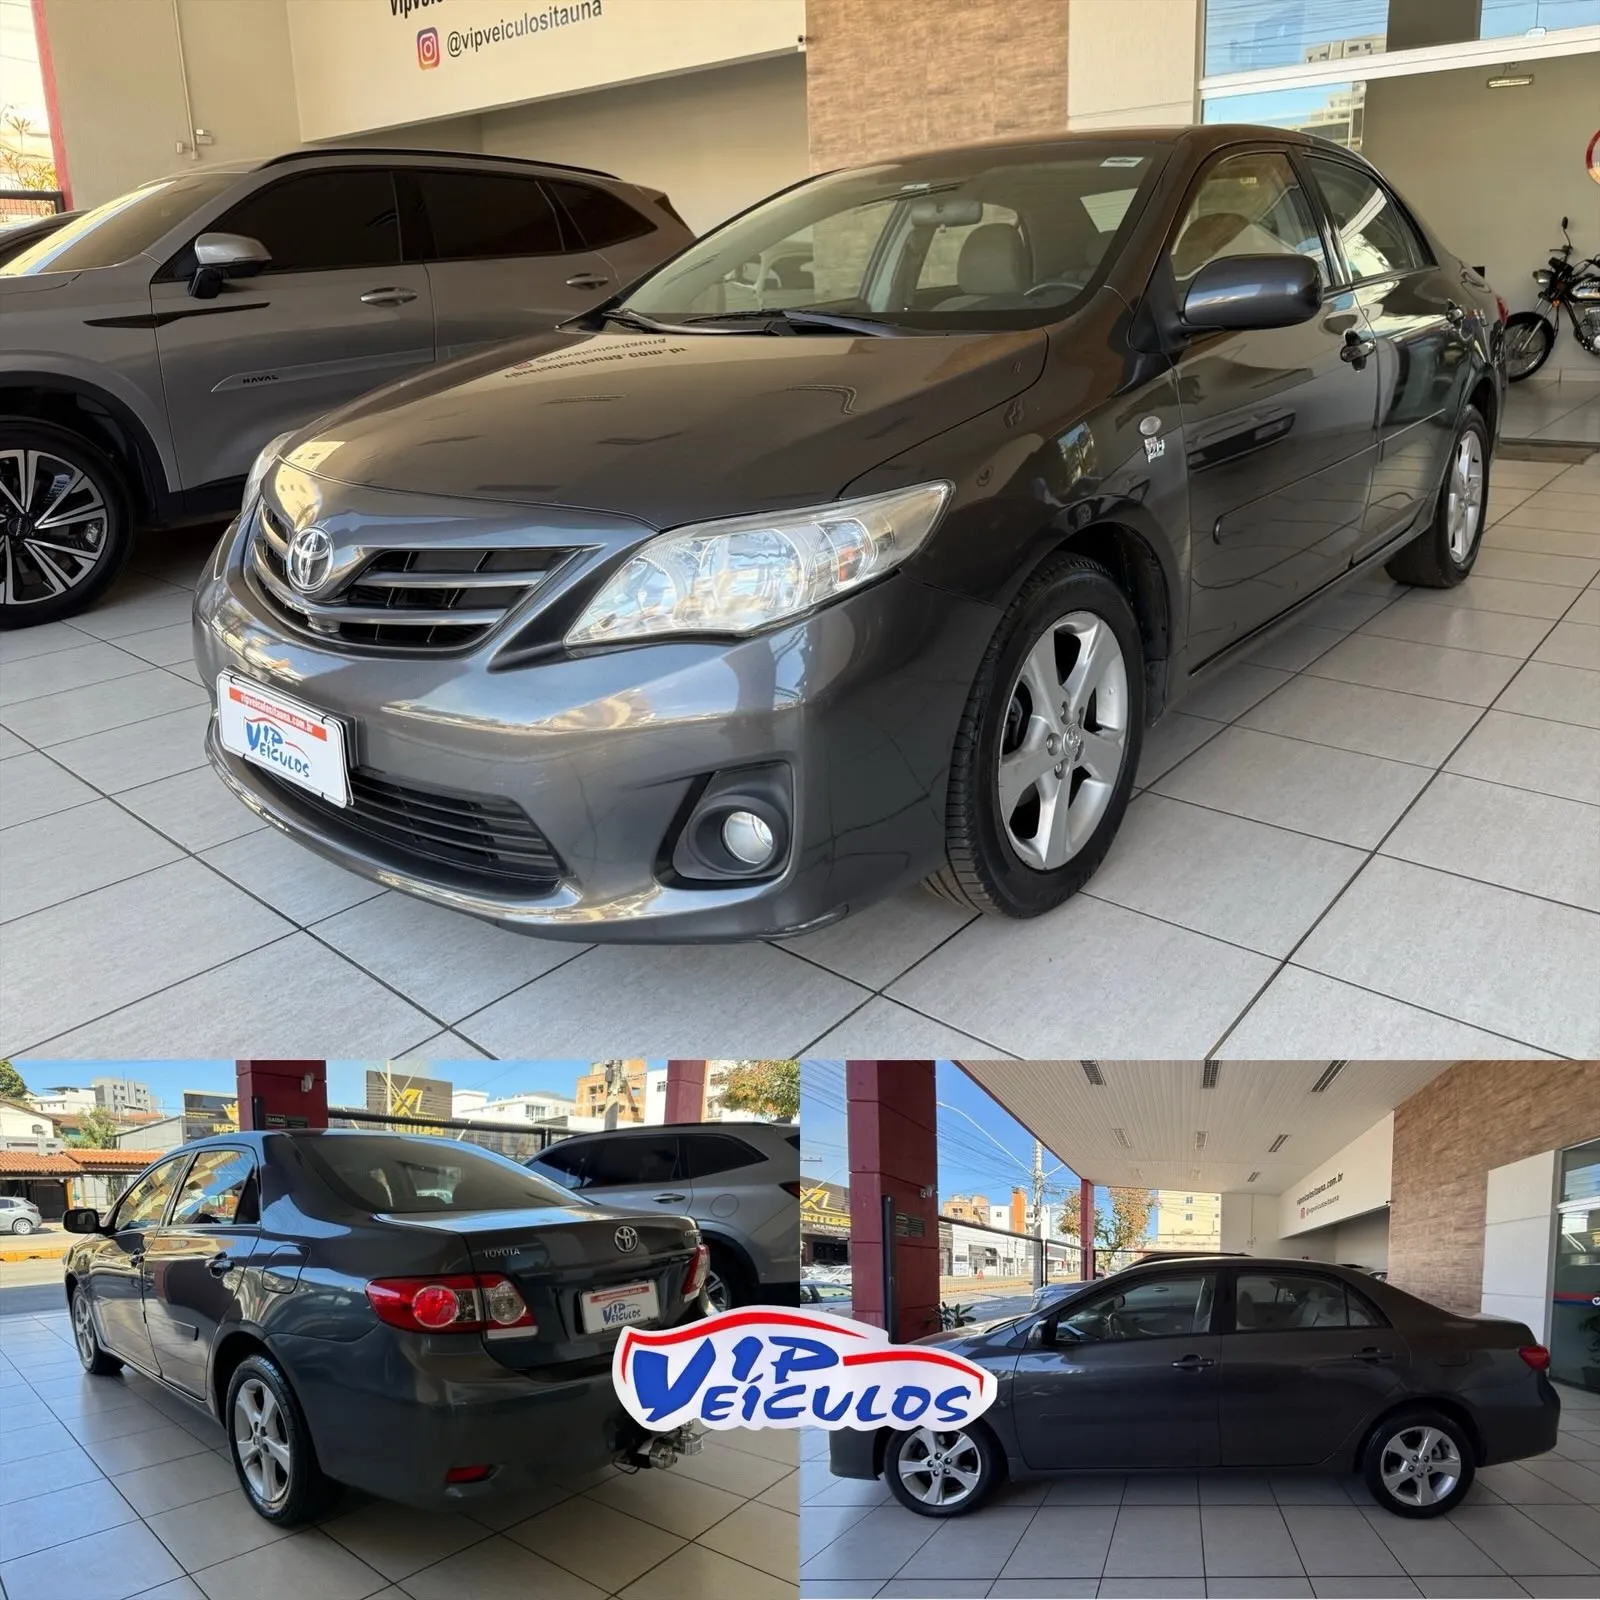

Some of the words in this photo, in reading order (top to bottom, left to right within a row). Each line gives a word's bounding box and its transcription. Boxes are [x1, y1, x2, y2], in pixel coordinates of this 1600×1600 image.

[447, 0, 602, 58] @vipveiculositauna
[242, 375, 279, 384] HAVAL
[483, 1247, 520, 1258] TOYOTA
